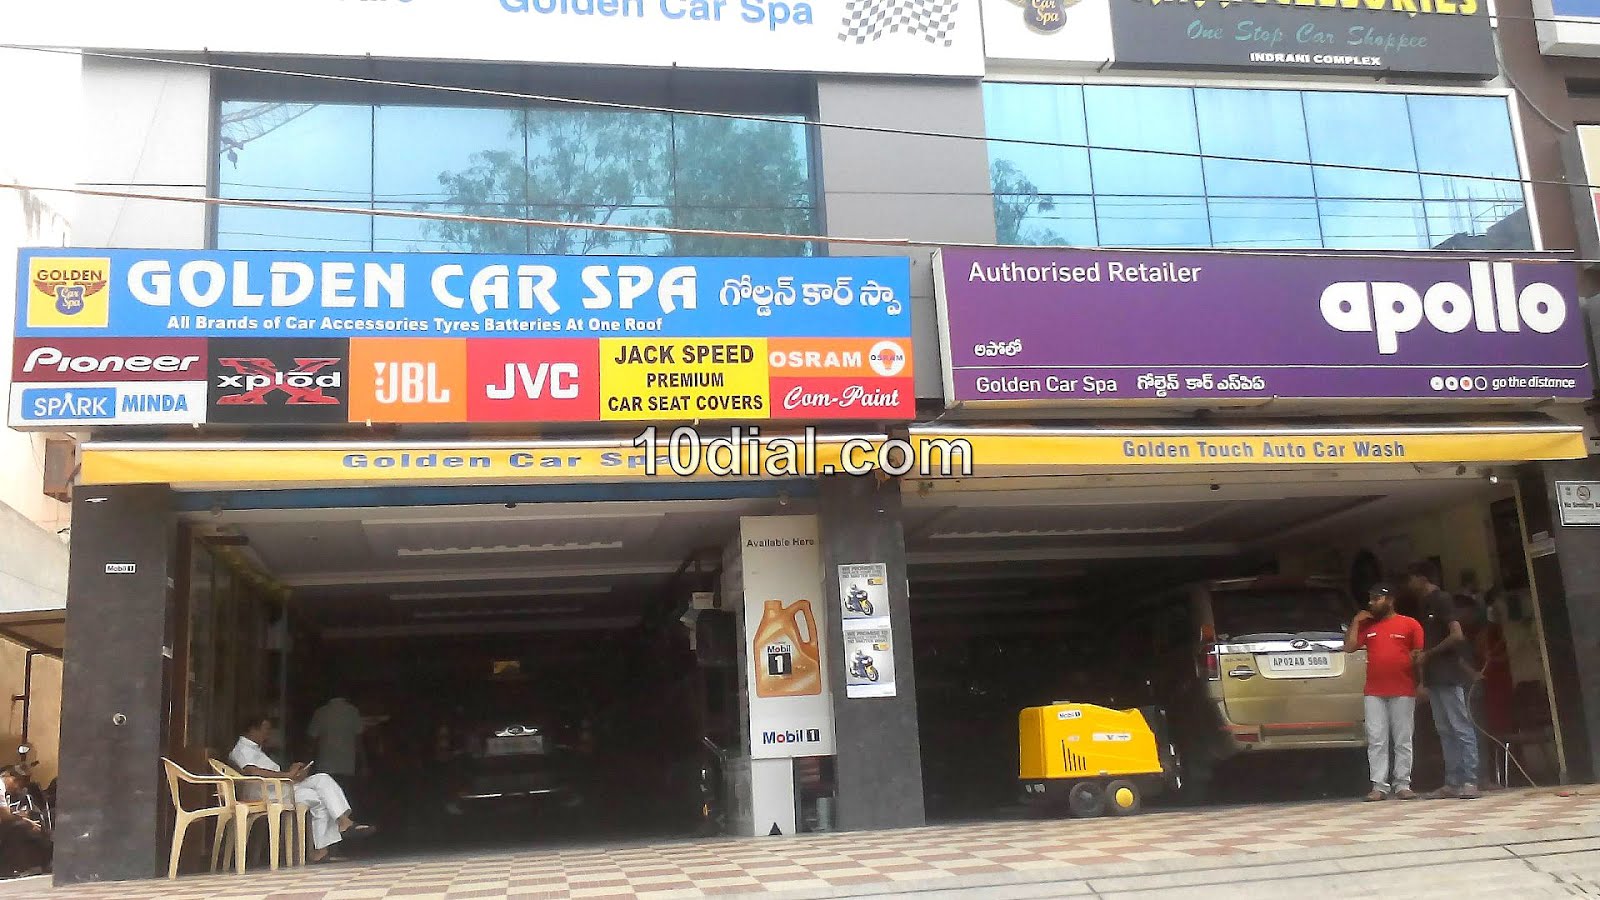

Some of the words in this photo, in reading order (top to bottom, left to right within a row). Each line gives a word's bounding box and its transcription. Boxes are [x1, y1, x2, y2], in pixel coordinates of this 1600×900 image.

[659, 0, 727, 21] Car
[741, 0, 813, 31] Spa
[1036, 8, 1060, 25] Spa
[1187, 19, 1224, 40] One
[1235, 20, 1283, 48] Stop
[1296, 22, 1335, 44] Car
[1249, 52, 1310, 63] INDRANI
[1313, 54, 1381, 66] COMPLEX
[37, 269, 102, 281] GOLDEN
[969, 261, 1100, 282] Authorised
[1109, 261, 1202, 282] Retailer
[61, 287, 79, 298] Car
[127, 260, 405, 308] GOLDEN
[430, 263, 560, 315] CAR
[582, 265, 698, 314] SPA
[802, 276, 854, 306] కార్
[859, 279, 902, 315] స్పా
[62, 297, 80, 309] Spa
[1320, 261, 1566, 354] apollo
[167, 316, 190, 330] All
[195, 316, 258, 330] Brands
[263, 316, 281, 330] of
[286, 317, 316, 330] Car
[320, 317, 428, 331] Accessories
[434, 317, 480, 331] Tyres
[484, 317, 561, 331] Batteries
[566, 318, 584, 331] At
[588, 318, 620, 331] One
[625, 317, 662, 331] Roof
[614, 346, 675, 364] JACK
[682, 345, 754, 364] SPEED
[974, 338, 1022, 357] అపోలో
[22, 346, 200, 373] Pioneer
[769, 351, 862, 367] OSRAM
[375, 361, 450, 404] JBL
[486, 363, 579, 399] JVC
[647, 372, 724, 388] PREMIUM
[976, 376, 1041, 392] Golden
[1045, 376, 1078, 392] Car
[1083, 376, 1117, 395] Spa
[1185, 373, 1213, 390] కార్
[1492, 378, 1506, 390] go
[1508, 376, 1526, 388] the
[1528, 376, 1576, 388] distance
[33, 391, 107, 417] SPARK
[120, 393, 188, 413] MINDA
[608, 397, 642, 412] CAR
[648, 396, 691, 411] SEAT
[696, 395, 763, 411] COVERS
[783, 385, 900, 410] Com-Paint
[1123, 440, 1190, 458] Golden
[1197, 441, 1254, 458] Touch
[1263, 440, 1306, 458] Auto
[1313, 441, 1346, 458] Car
[1353, 440, 1406, 458] Wash
[342, 453, 491, 468] Golden
[510, 452, 581, 468] Car
[747, 538, 790, 547] Available
[793, 538, 814, 546] Here
[767, 645, 791, 653] Mobil
[763, 730, 803, 744] Mobil
